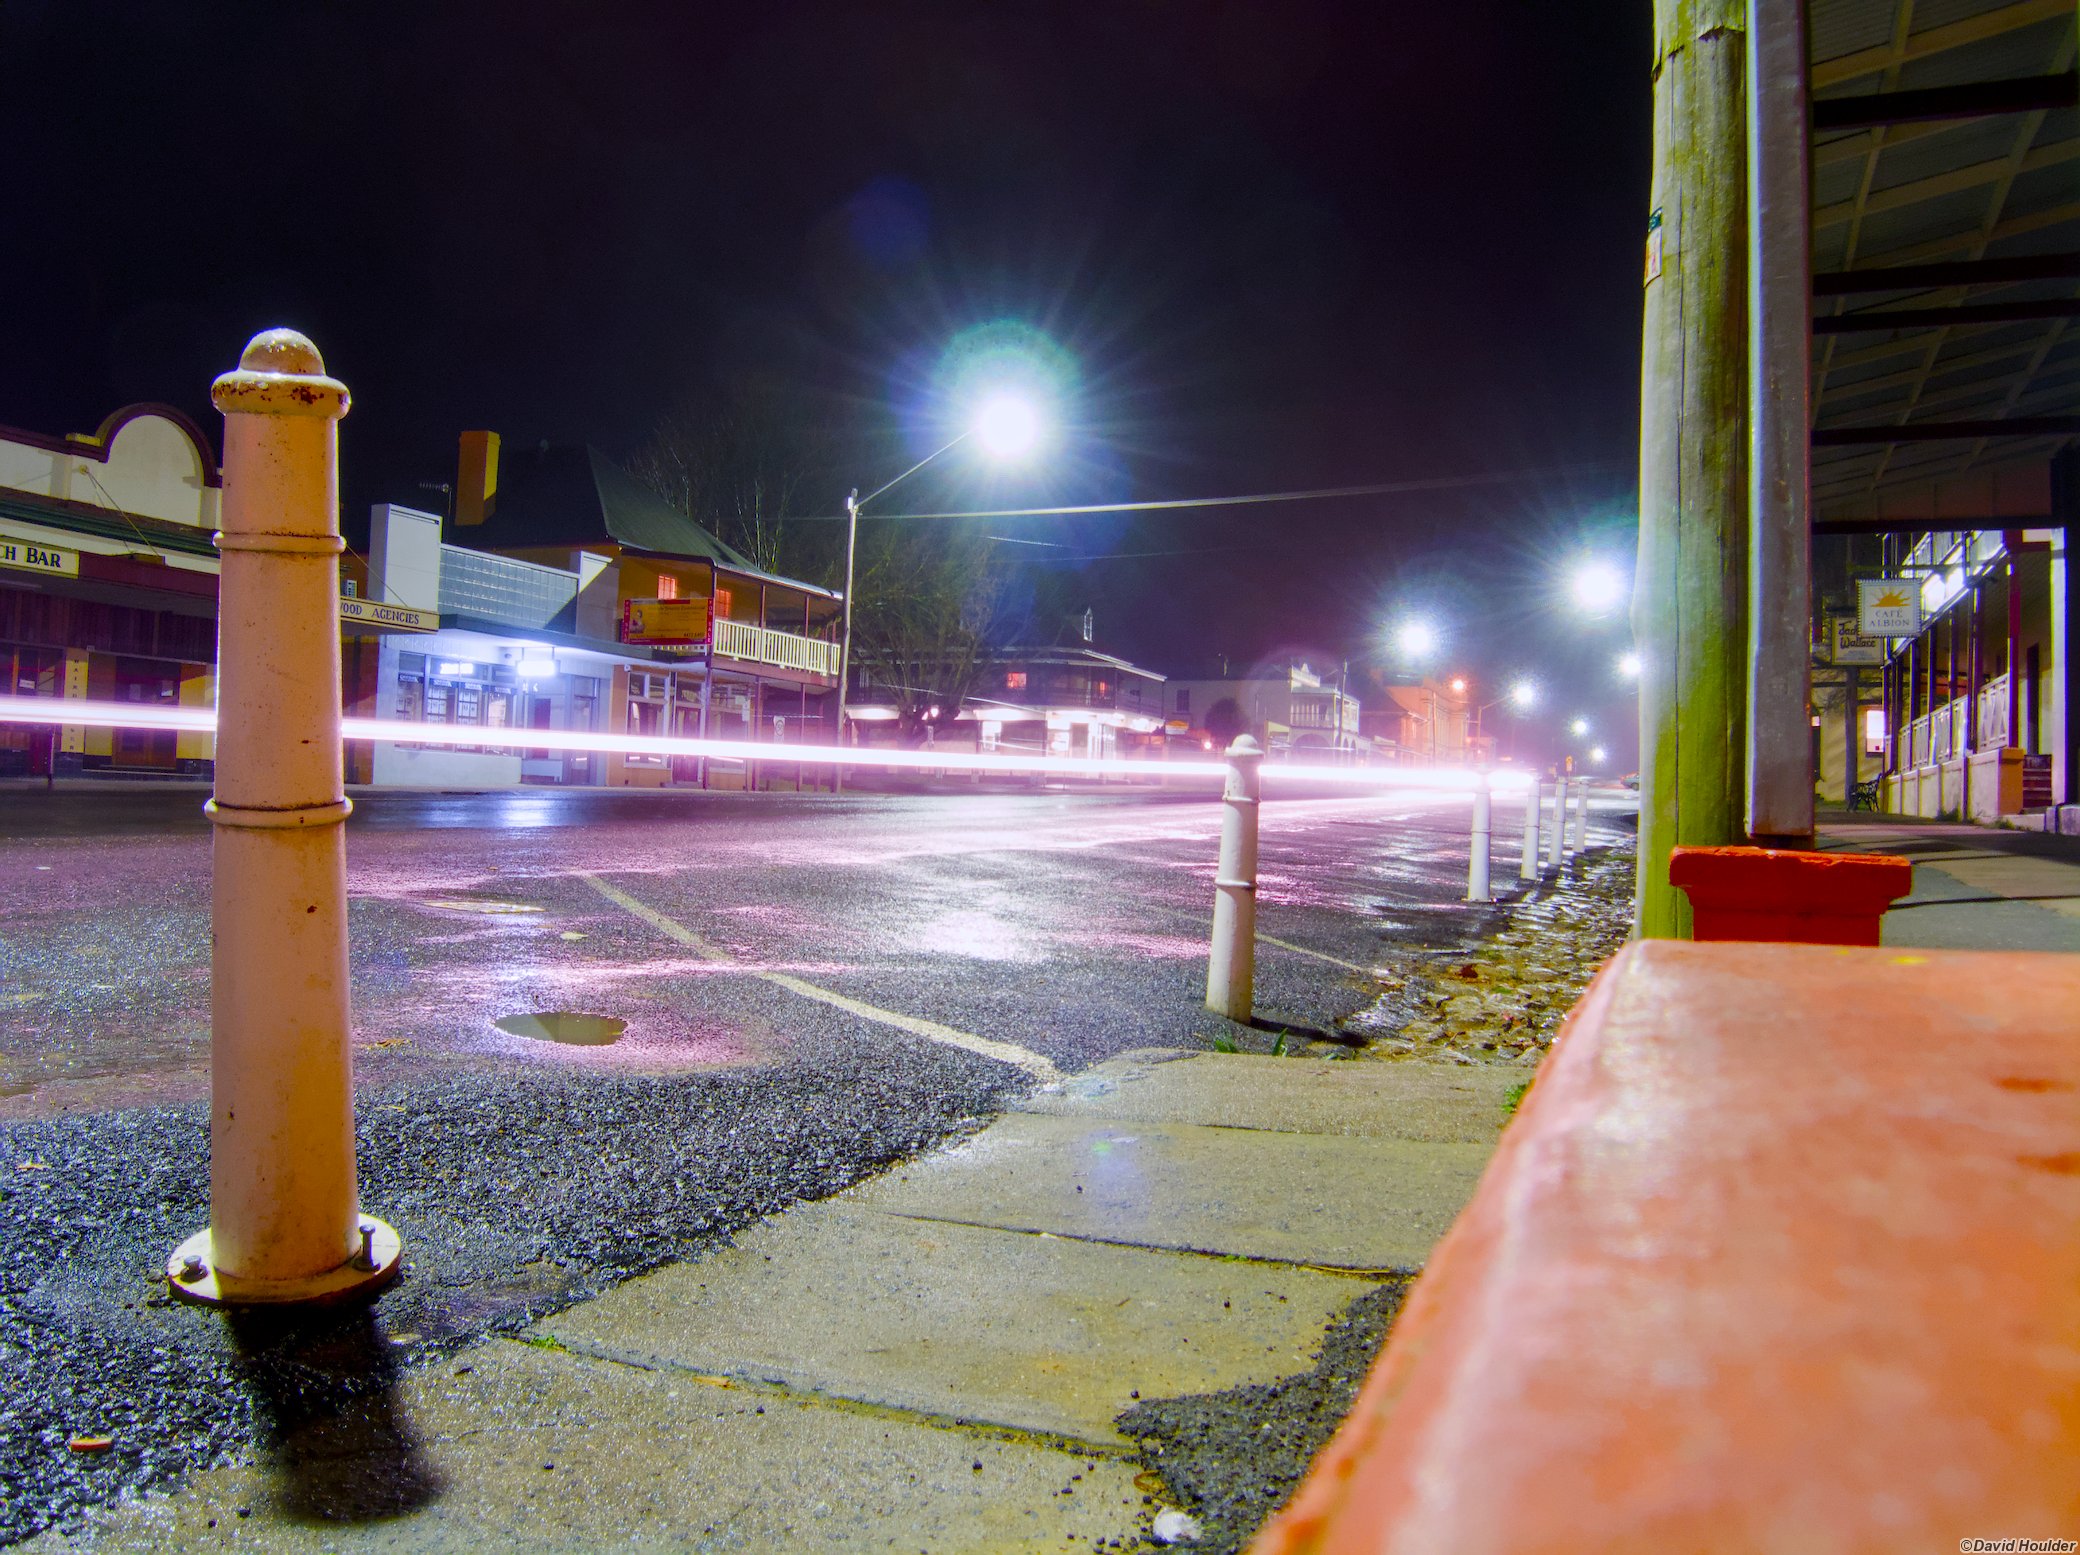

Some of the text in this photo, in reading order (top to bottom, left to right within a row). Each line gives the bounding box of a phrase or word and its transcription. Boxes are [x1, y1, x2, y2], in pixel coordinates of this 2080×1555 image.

[26, 547, 61, 568] BAR
[371, 608, 420, 625] AGENCIES
[1868, 619, 1909, 628] ALBION
[1840, 636, 1876, 649] Wallace
